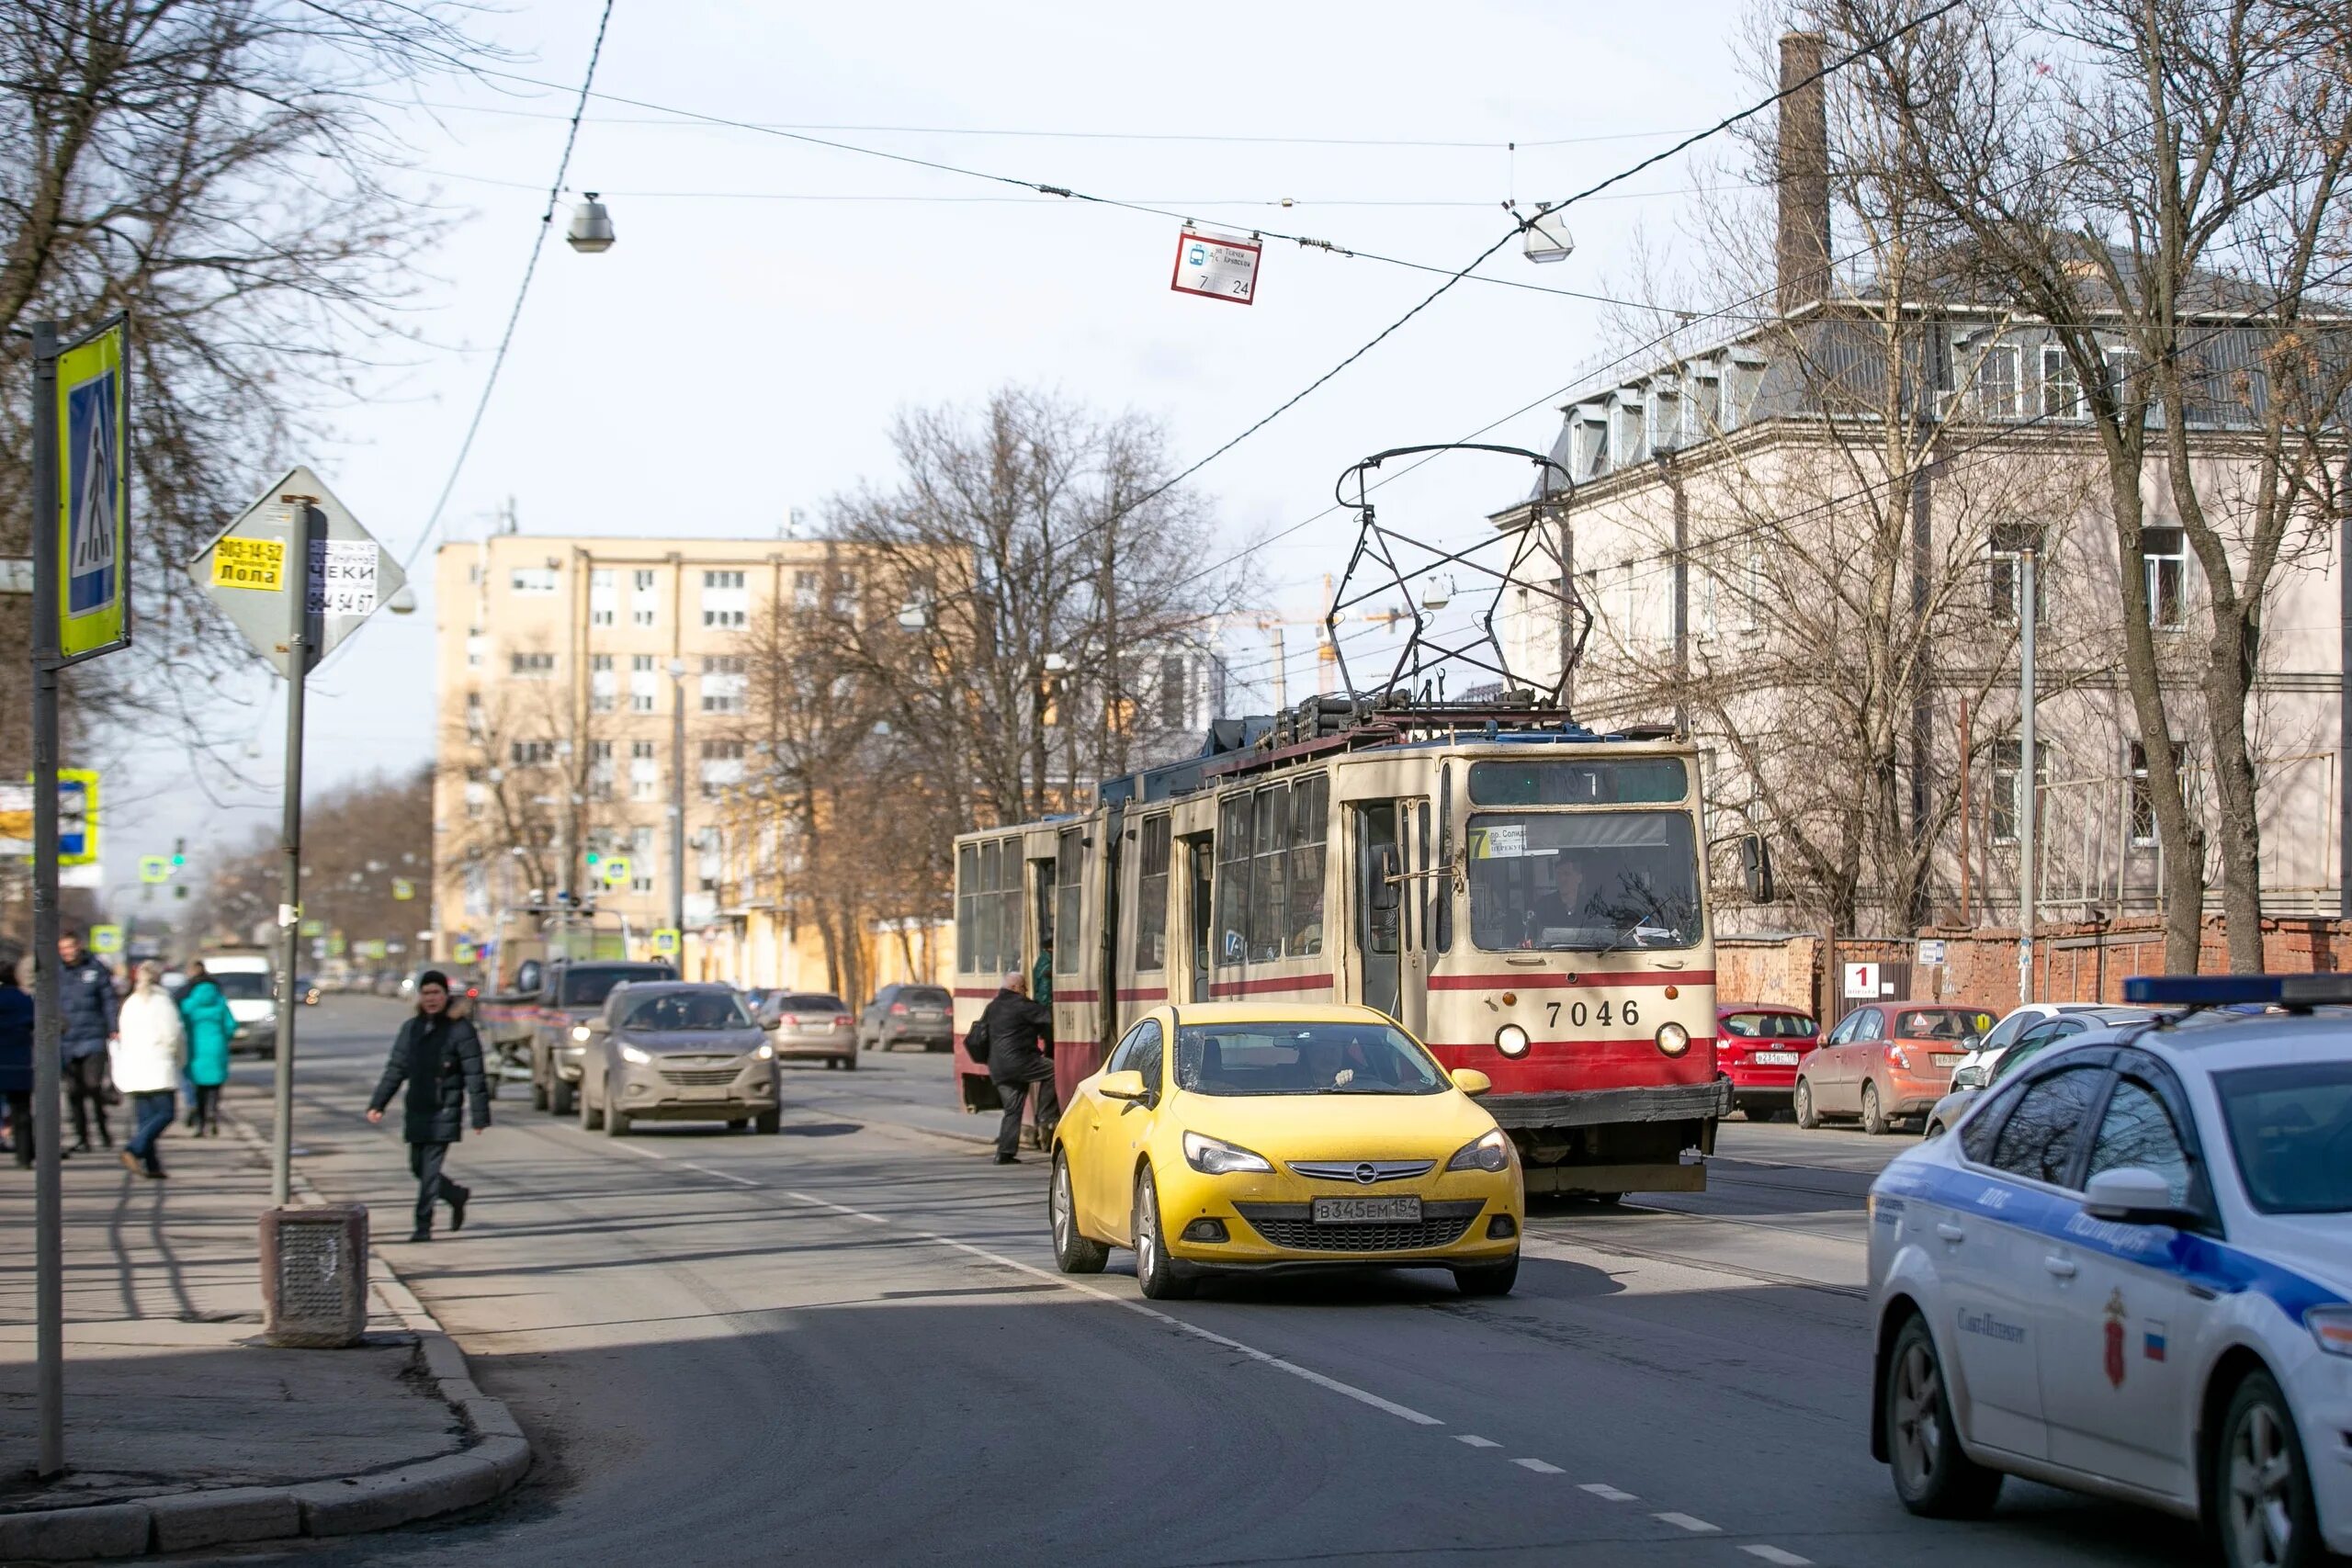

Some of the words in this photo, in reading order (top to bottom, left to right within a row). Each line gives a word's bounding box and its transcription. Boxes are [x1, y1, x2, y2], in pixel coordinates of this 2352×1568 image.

[1200, 275, 1209, 288] 7
[1233, 279, 1250, 296] 24
[220, 564, 276, 584] Лола
[310, 565, 375, 580] ЧЕКИ
[1468, 829, 1487, 858] 7
[1856, 966, 1867, 987] 1
[1546, 999, 1640, 1028] 7046
